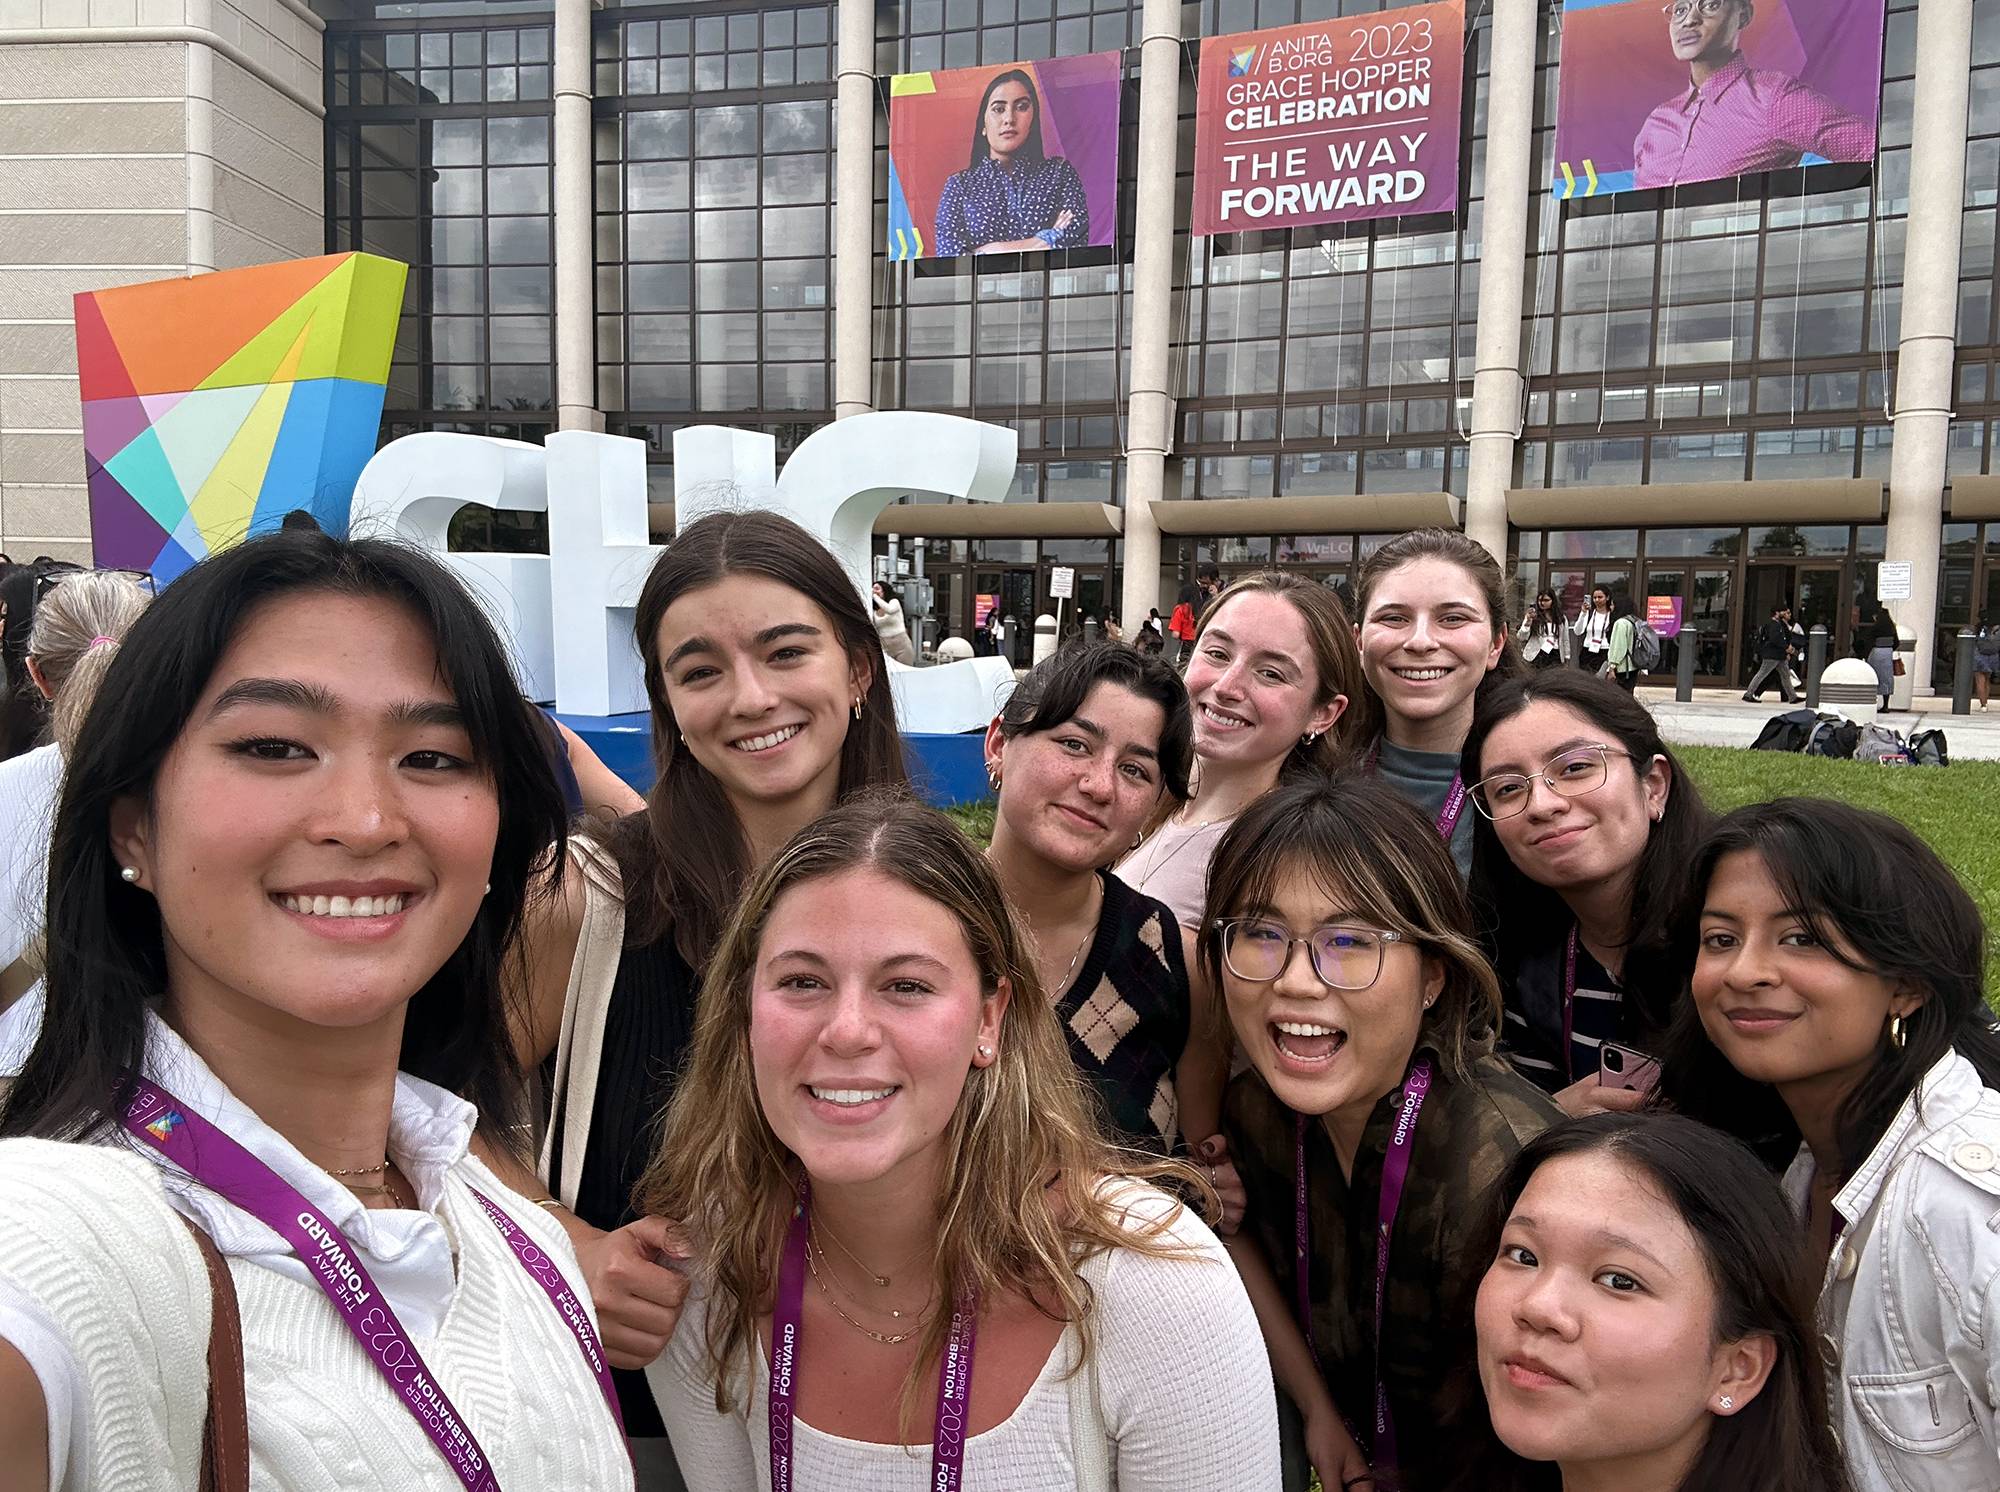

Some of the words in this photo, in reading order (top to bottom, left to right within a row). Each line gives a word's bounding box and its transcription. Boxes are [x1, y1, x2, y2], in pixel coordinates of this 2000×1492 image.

[1269, 50, 1333, 74] B.ORG
[1271, 33, 1332, 57] ANITA
[1349, 18, 1433, 63] 2023
[1226, 73, 1313, 105] GRACE
[1321, 57, 1432, 93] HOPPER
[1225, 83, 1431, 131] CELEBRATION
[1223, 147, 1307, 183] THE
[1328, 132, 1428, 171] WAY
[1220, 169, 1426, 221] FORWARD
[1306, 542, 1381, 554] WELCM
[349, 410, 1018, 736] GHC
[1394, 1091, 1417, 1146] FORWARD
[1409, 1112, 1418, 1130] WAY
[1415, 1094, 1424, 1110] THE
[297, 1212, 371, 1305] FORWARD
[312, 1253, 338, 1284] WAY
[510, 1233, 560, 1288] 2023
[335, 1283, 357, 1314] THE
[562, 1287, 579, 1311] THE
[579, 1312, 594, 1338] WAY
[360, 1307, 417, 1383] 2023
[556, 1292, 602, 1374] FORWARD
[774, 1347, 783, 1370] WAY
[780, 1323, 795, 1396] FORWARD
[955, 1355, 967, 1400] HOPPER
[772, 1373, 781, 1393] THE
[405, 1383, 447, 1439] HOPPER
[413, 1372, 483, 1471] CELEBRATION
[772, 1402, 788, 1454] 2023
[939, 1402, 962, 1457] 2023
[444, 1435, 476, 1482] GRACE
[780, 1455, 788, 1492] ATION
[948, 1466, 957, 1487] THE
